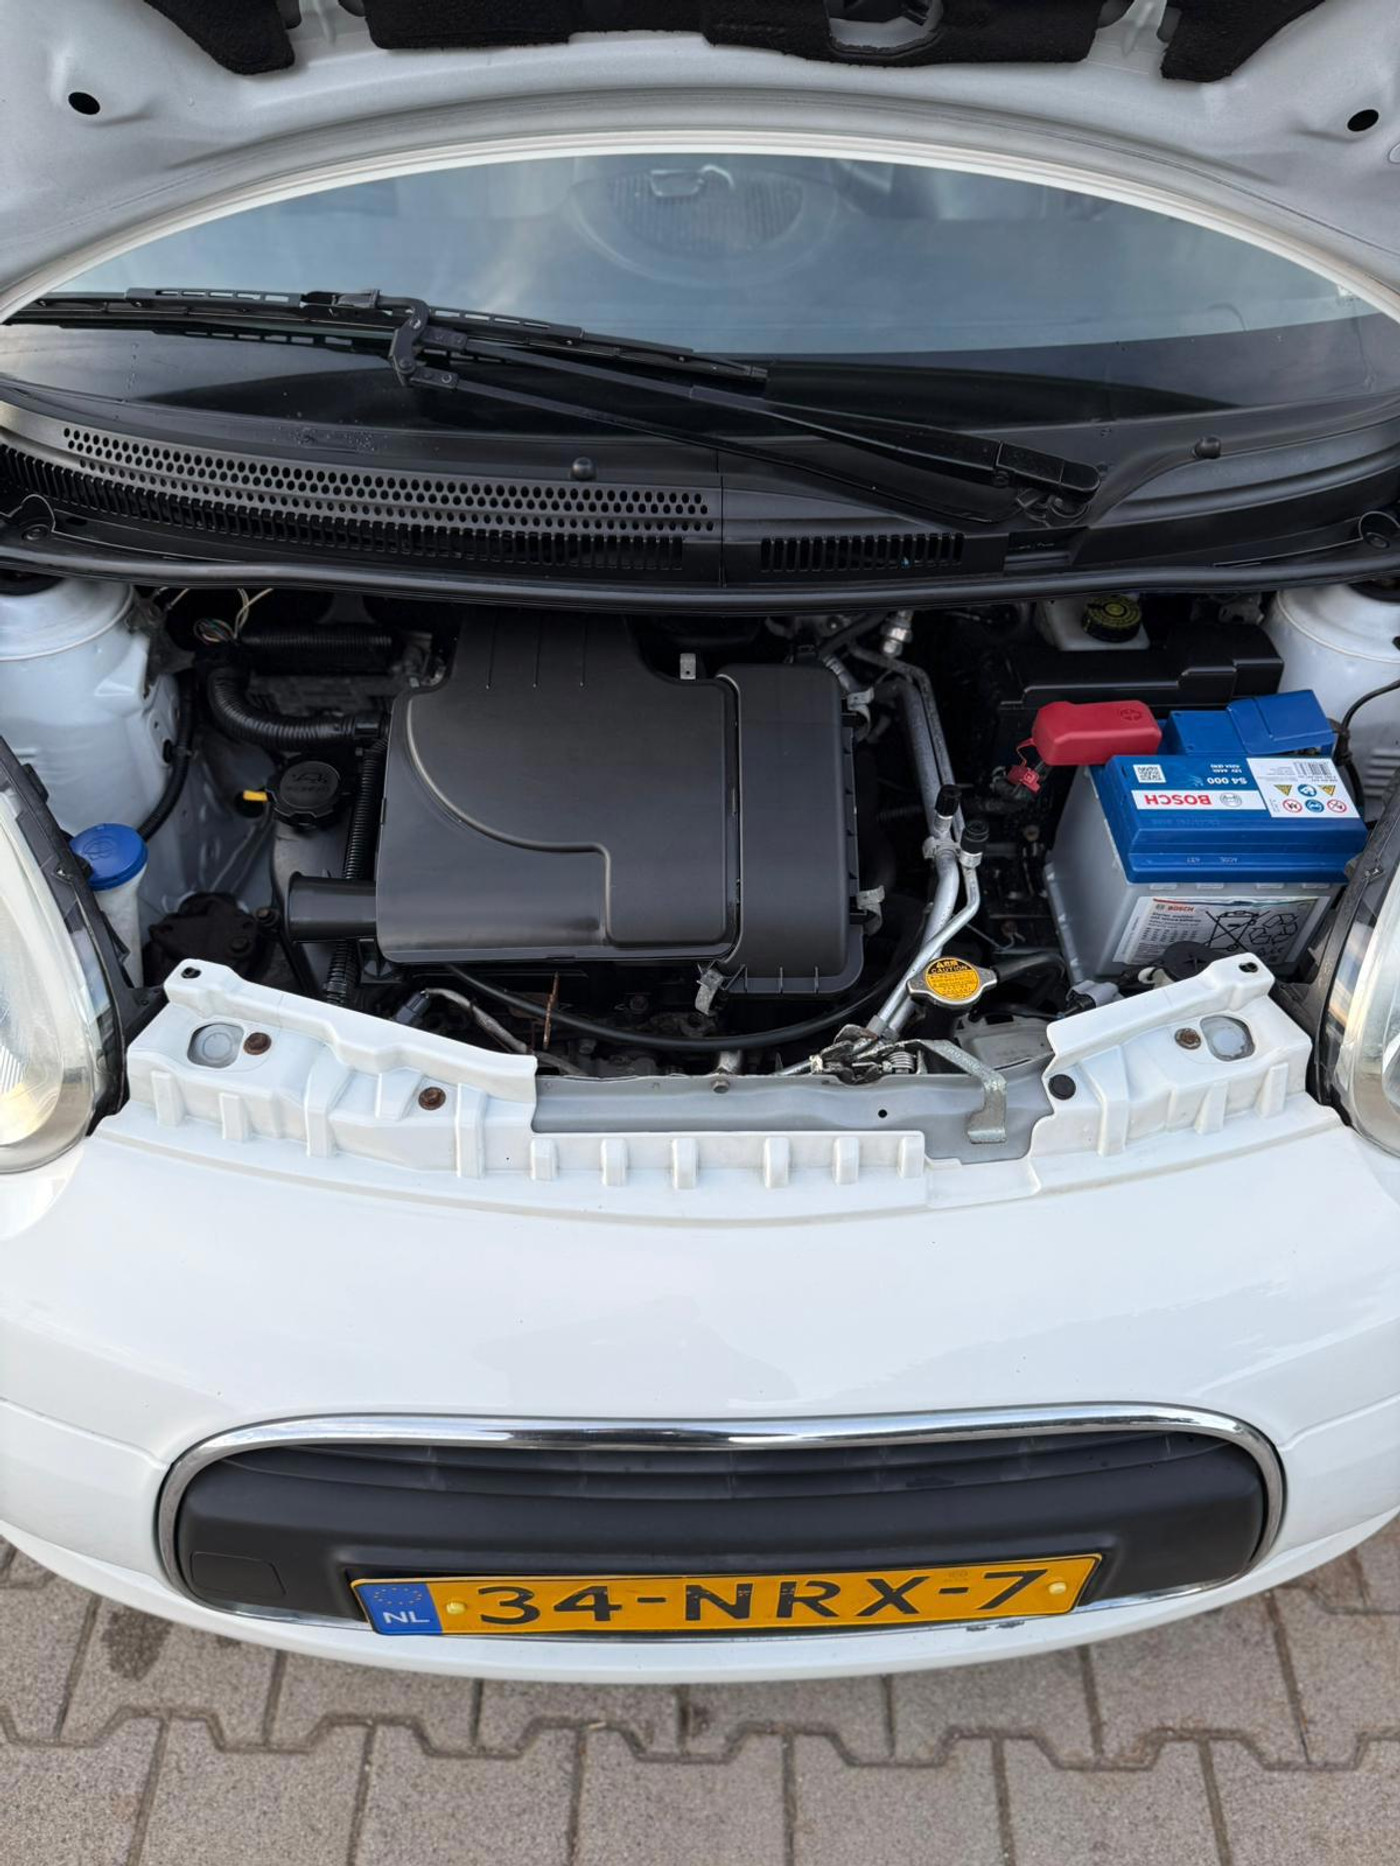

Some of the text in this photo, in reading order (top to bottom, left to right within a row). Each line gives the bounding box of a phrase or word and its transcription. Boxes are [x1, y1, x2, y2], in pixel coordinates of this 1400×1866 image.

[1207, 776, 1248, 785] S4 000
[1144, 794, 1212, 806] BOSCH
[1167, 904, 1195, 912] BOSCH
[931, 965, 968, 973] CAUTION
[478, 1568, 1048, 1625] 34-NRX-7
[383, 1611, 431, 1625] NL
